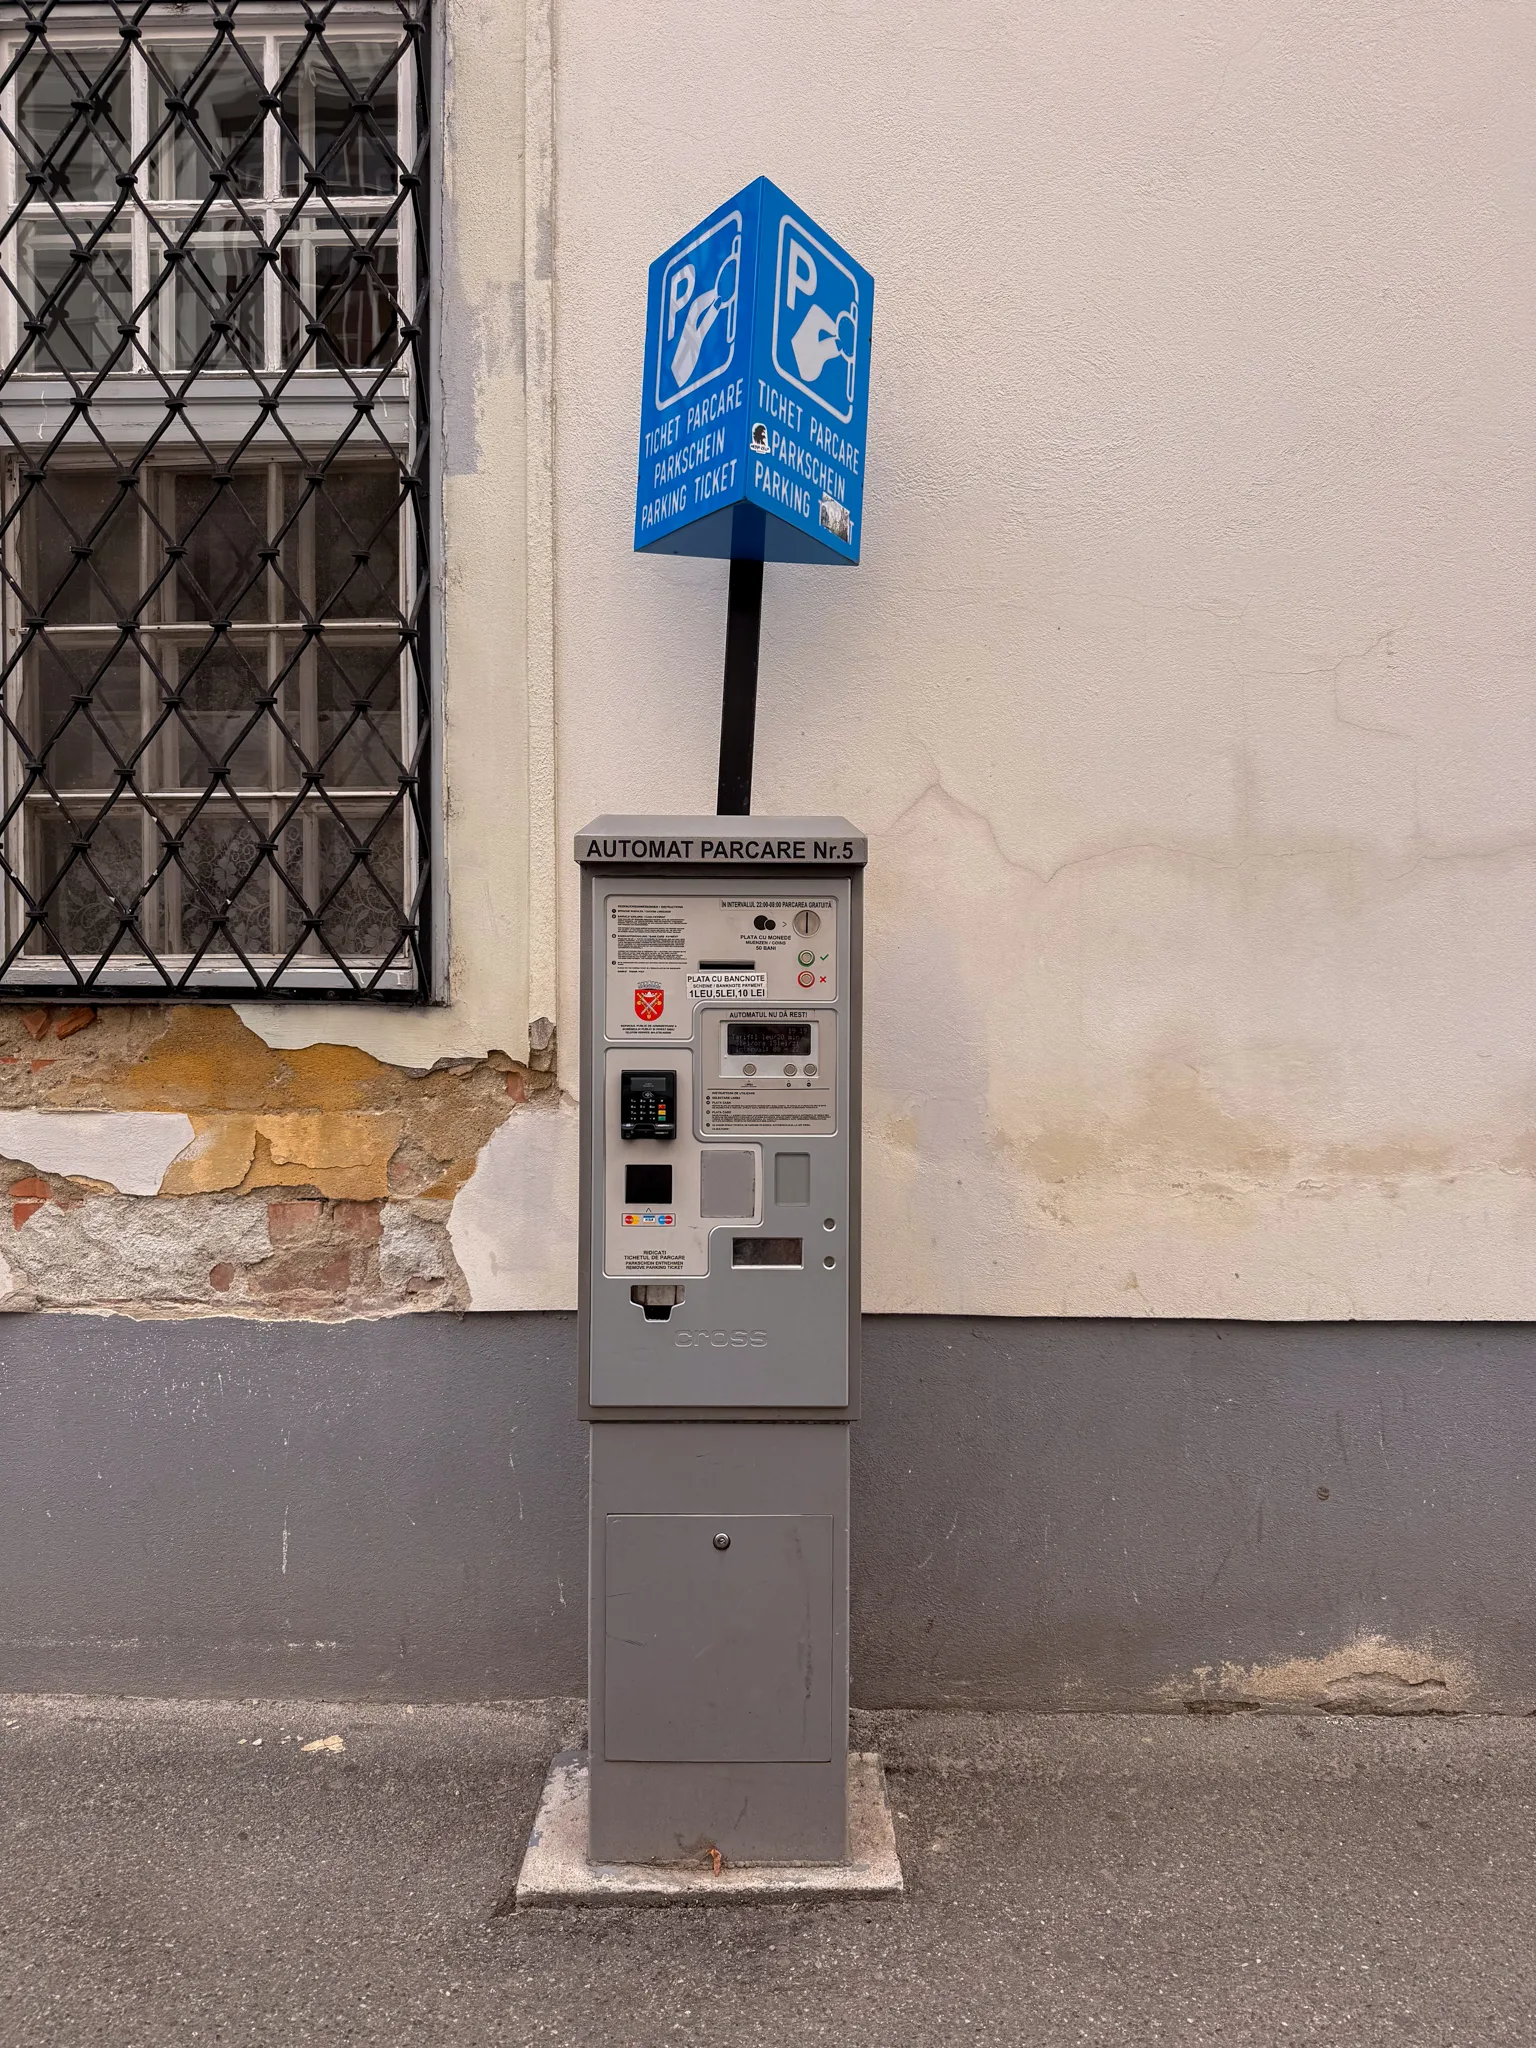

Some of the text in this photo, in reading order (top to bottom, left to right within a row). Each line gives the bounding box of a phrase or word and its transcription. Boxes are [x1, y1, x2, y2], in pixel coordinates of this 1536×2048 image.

[668, 263, 696, 342] P
[786, 238, 818, 311] P
[645, 378, 743, 459] TICHET PARCARE
[758, 379, 859, 475] TICHET PARCARE
[654, 427, 725, 489] PARKSCHEIN
[754, 460, 811, 518] PARKING
[772, 430, 845, 503] PARKSCHEIN
[641, 458, 737, 531] PARKING TICKET
[586, 840, 853, 860] AUTOMAT PARCARE Nr.5
[687, 975, 711, 983] PLATA
[712, 975, 723, 983] CU
[751, 988, 765, 997] LEI
[675, 1329, 768, 1347] cross
